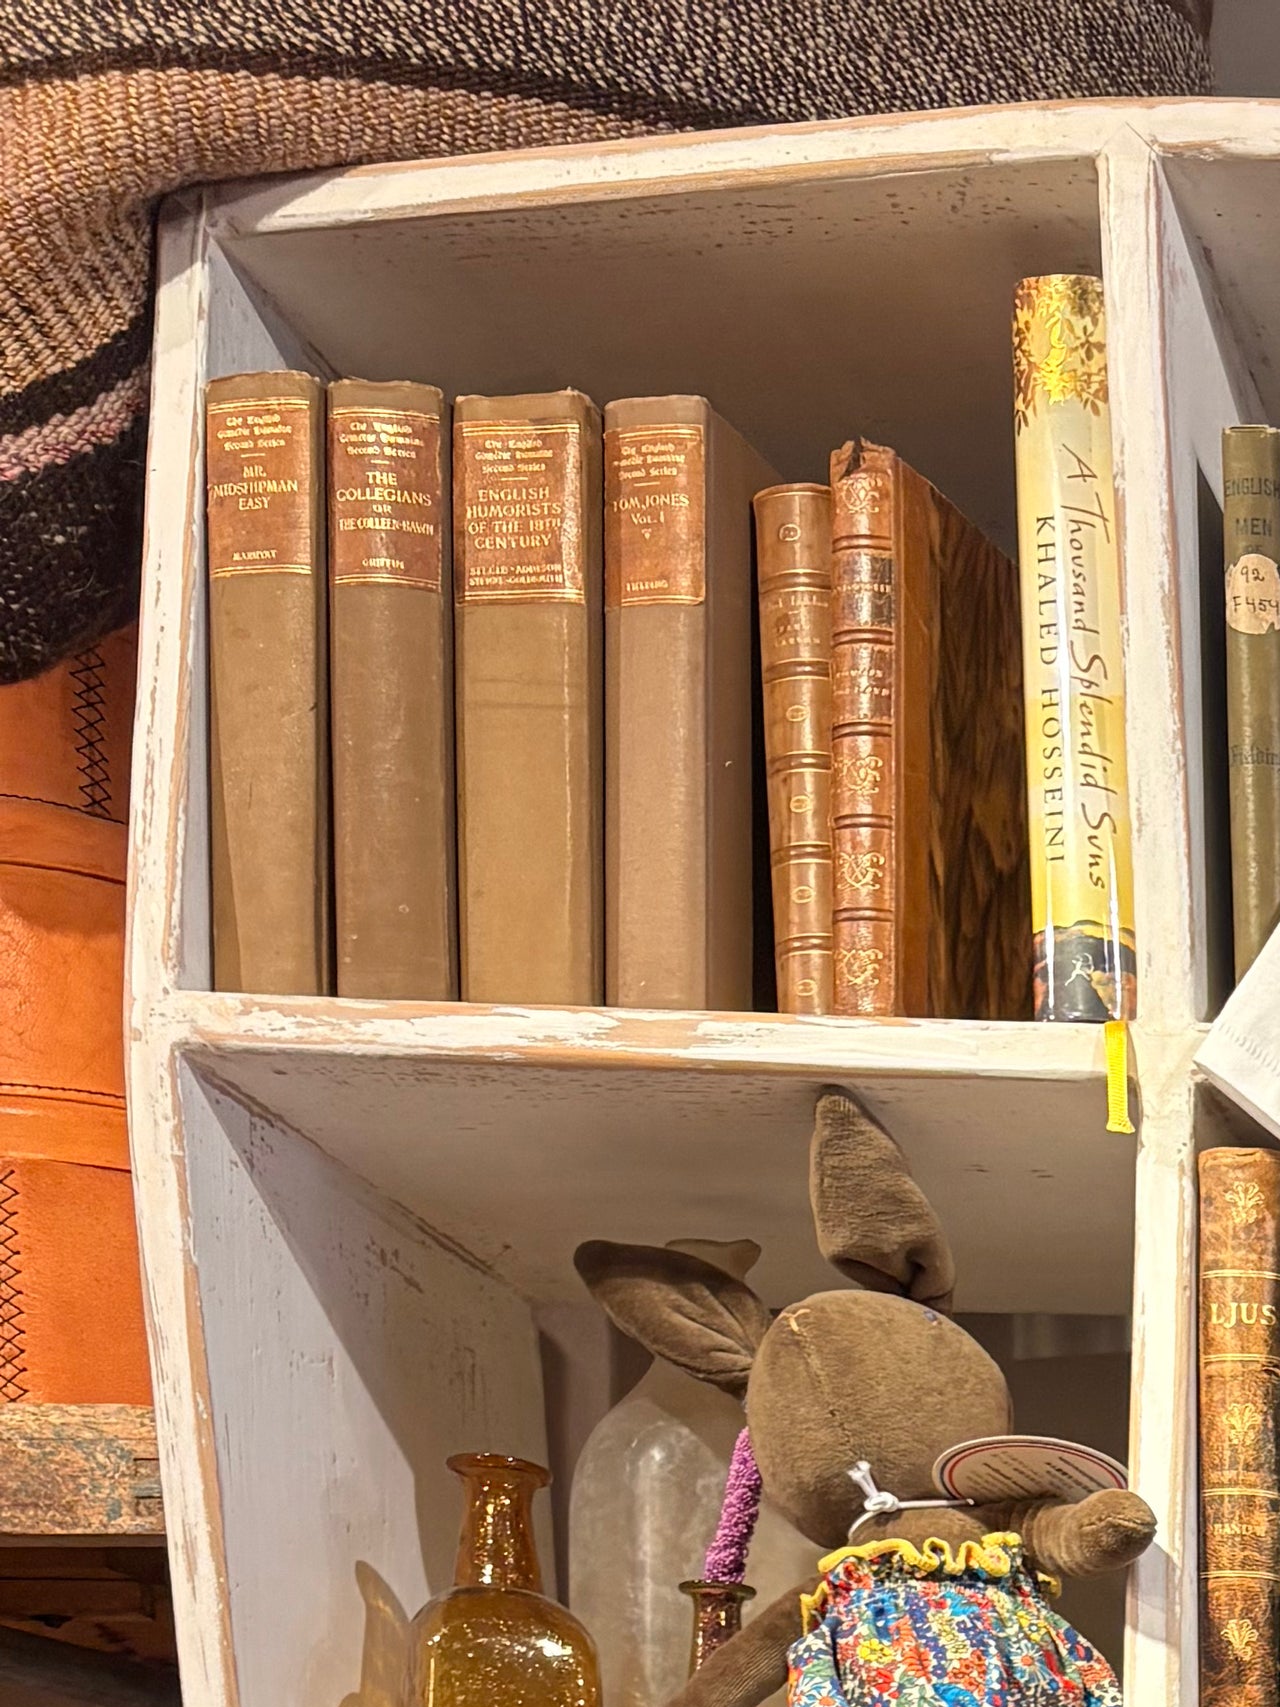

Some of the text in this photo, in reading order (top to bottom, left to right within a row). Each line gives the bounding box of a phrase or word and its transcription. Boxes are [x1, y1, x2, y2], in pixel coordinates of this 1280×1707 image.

[366, 471, 398, 486] THE
[1224, 476, 1280, 499] ENGLISH
[212, 479, 298, 499] MIDSHIPMAN
[336, 487, 432, 507] COLLEGIANS
[478, 486, 550, 502] ENGLISH
[238, 497, 271, 511] EASY
[466, 502, 562, 519] HUMORISTS
[468, 521, 488, 535] OF
[493, 520, 521, 534] THE
[1235, 517, 1273, 537] MEN
[474, 533, 551, 550] CENTURY
[1240, 565, 1265, 584] 92
[1060, 443, 1120, 890] A Thousand Splendid Suns
[1036, 515, 1066, 864] KHALED HOSSEINI
[1210, 1303, 1277, 1326] LJUS
